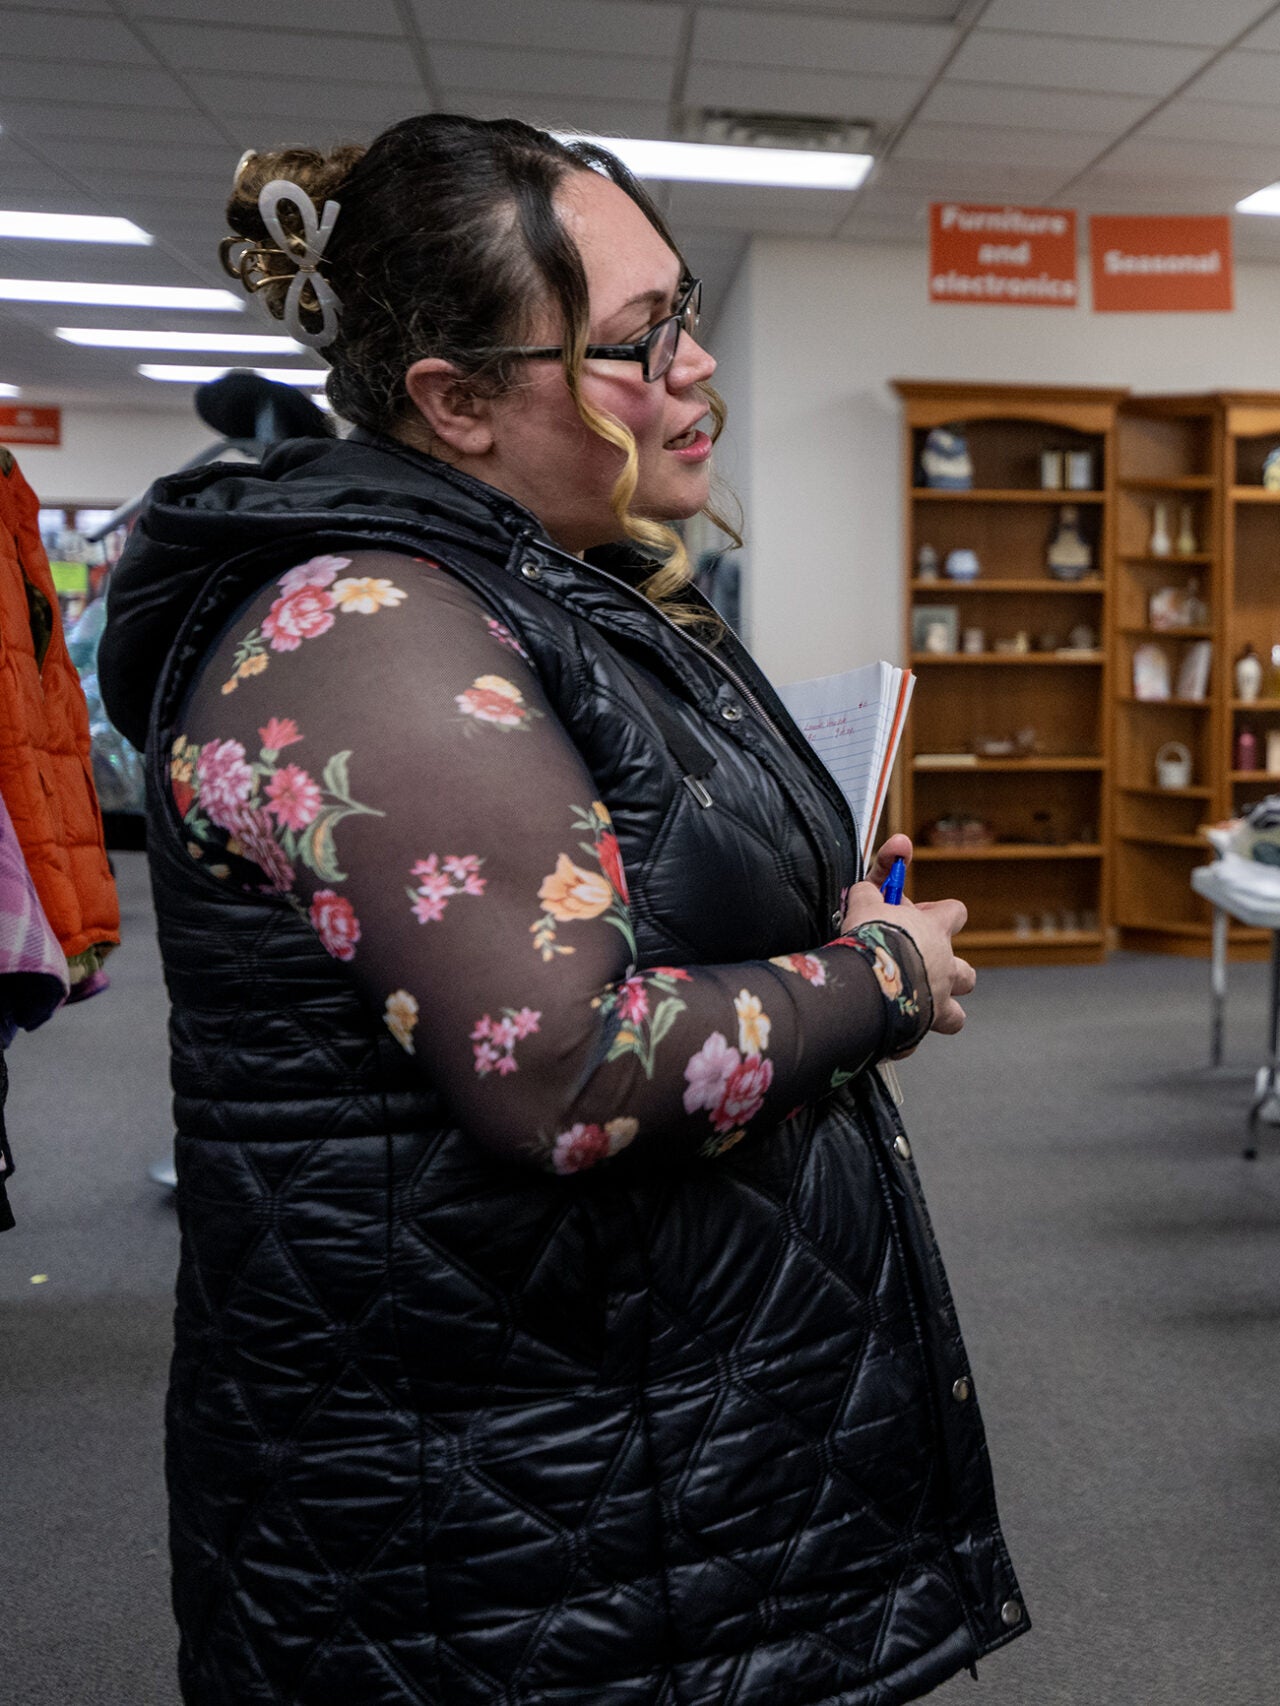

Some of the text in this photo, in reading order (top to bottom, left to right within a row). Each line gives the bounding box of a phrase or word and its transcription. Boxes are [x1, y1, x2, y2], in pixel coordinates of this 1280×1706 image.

[940, 205, 1067, 235] Furniture
[977, 241, 1031, 265] and
[1104, 250, 1221, 274] Seasonal
[932, 270, 1076, 298] electronics
